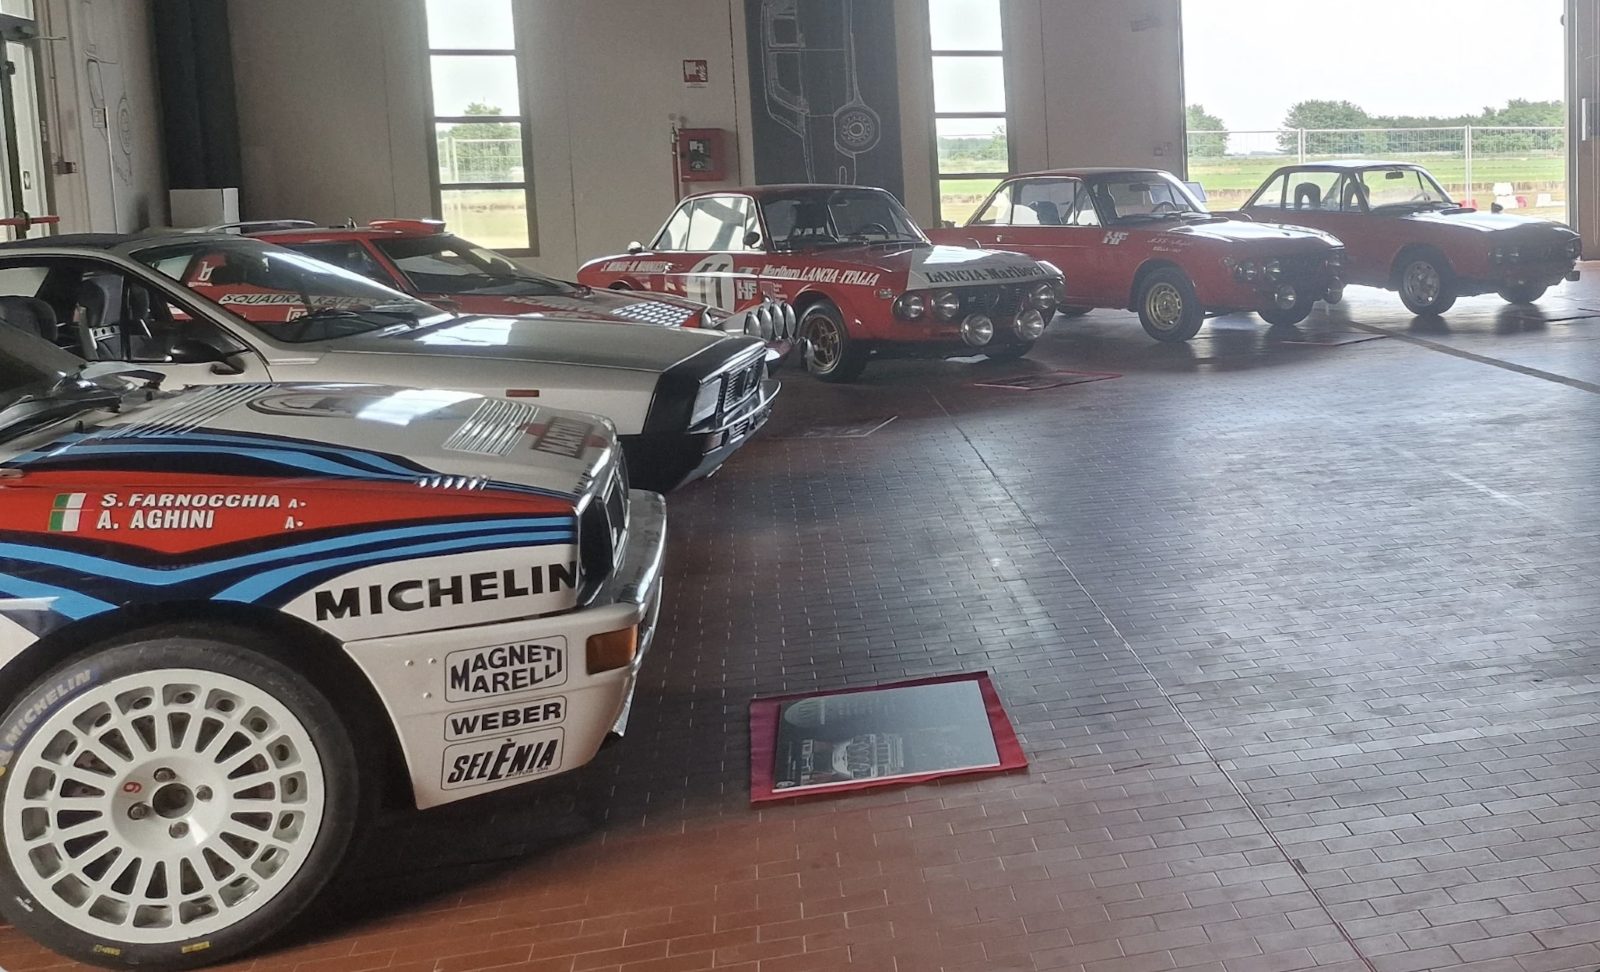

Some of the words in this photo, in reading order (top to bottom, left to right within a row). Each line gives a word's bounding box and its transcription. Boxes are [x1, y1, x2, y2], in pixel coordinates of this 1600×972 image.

[96, 509, 119, 529] A.
[130, 509, 215, 529] AGHINI
[101, 493, 124, 508] S.
[128, 493, 280, 508] FARNOCCHIA
[315, 560, 577, 621] MICHELIN
[451, 644, 562, 689] MAGNETI
[5, 669, 91, 747] MICHELIN
[451, 702, 561, 735] WEBER
